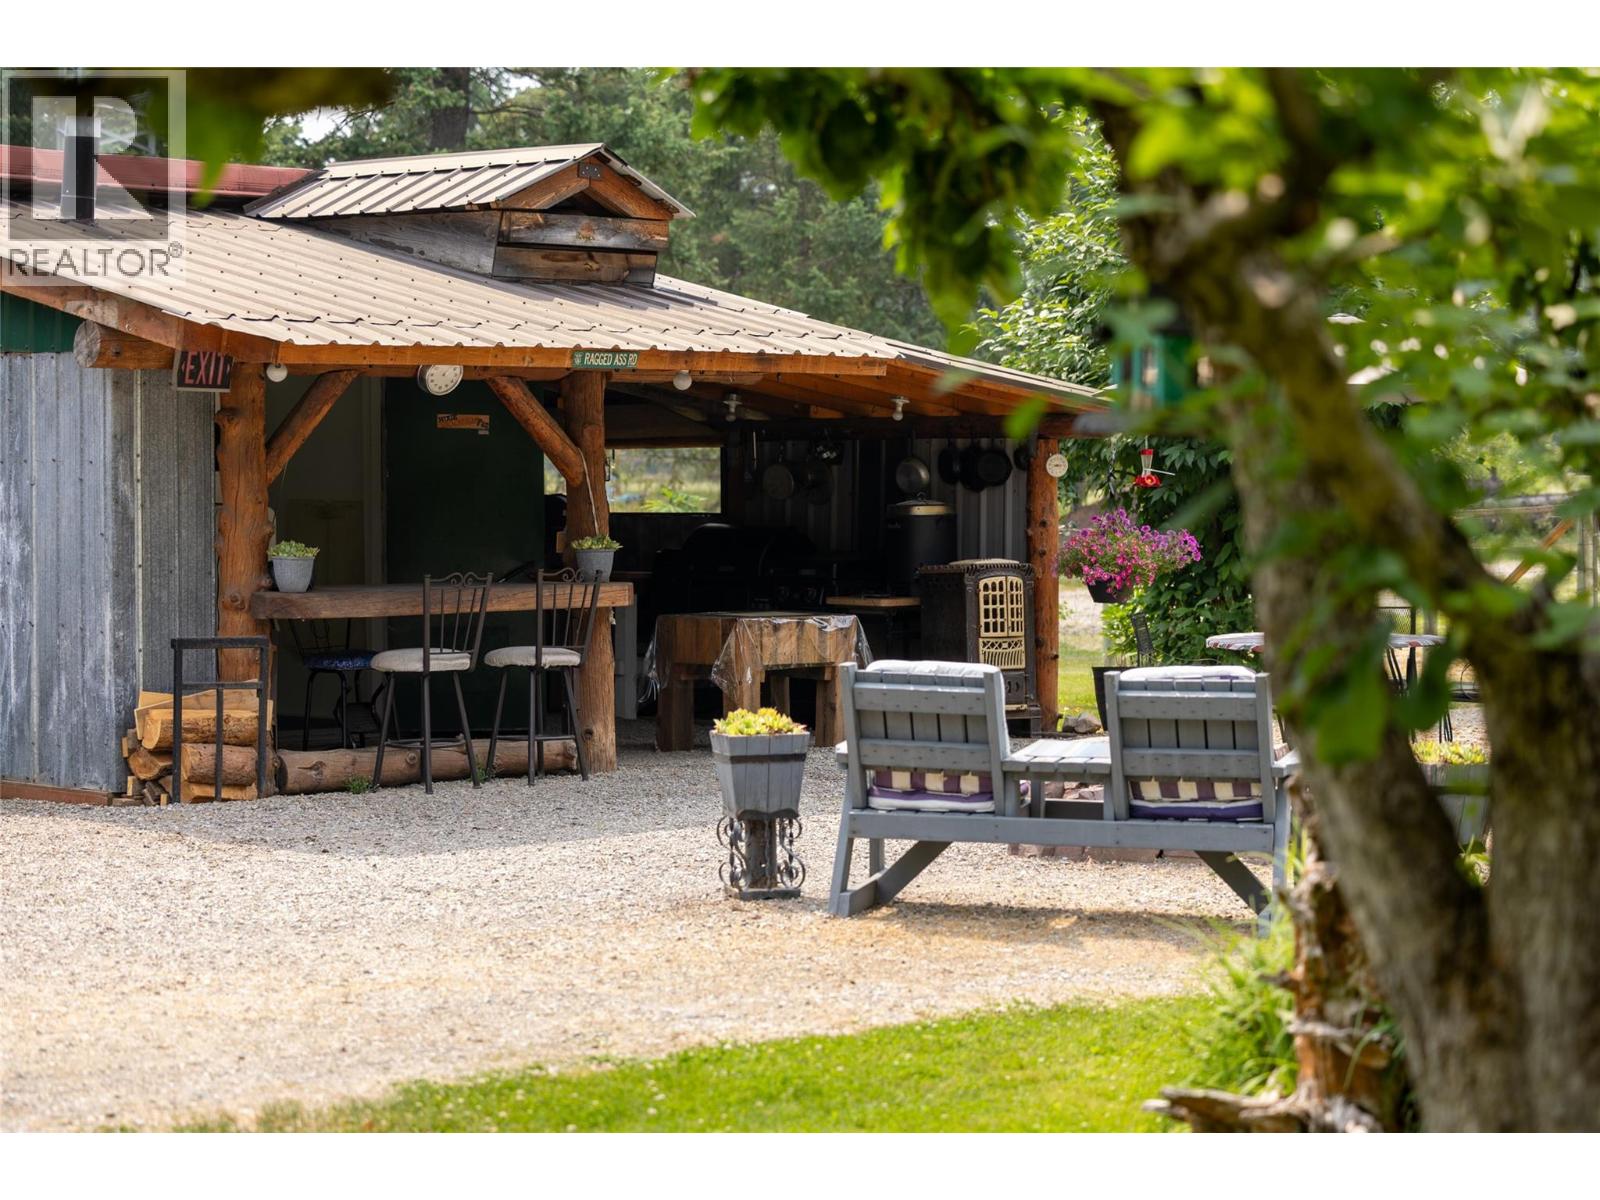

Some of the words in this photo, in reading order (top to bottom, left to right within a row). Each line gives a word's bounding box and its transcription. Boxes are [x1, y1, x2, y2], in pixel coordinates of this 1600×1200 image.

[184, 351, 226, 385] EXIT
[584, 352, 613, 366] RAGGED
[613, 353, 628, 366] ASS
